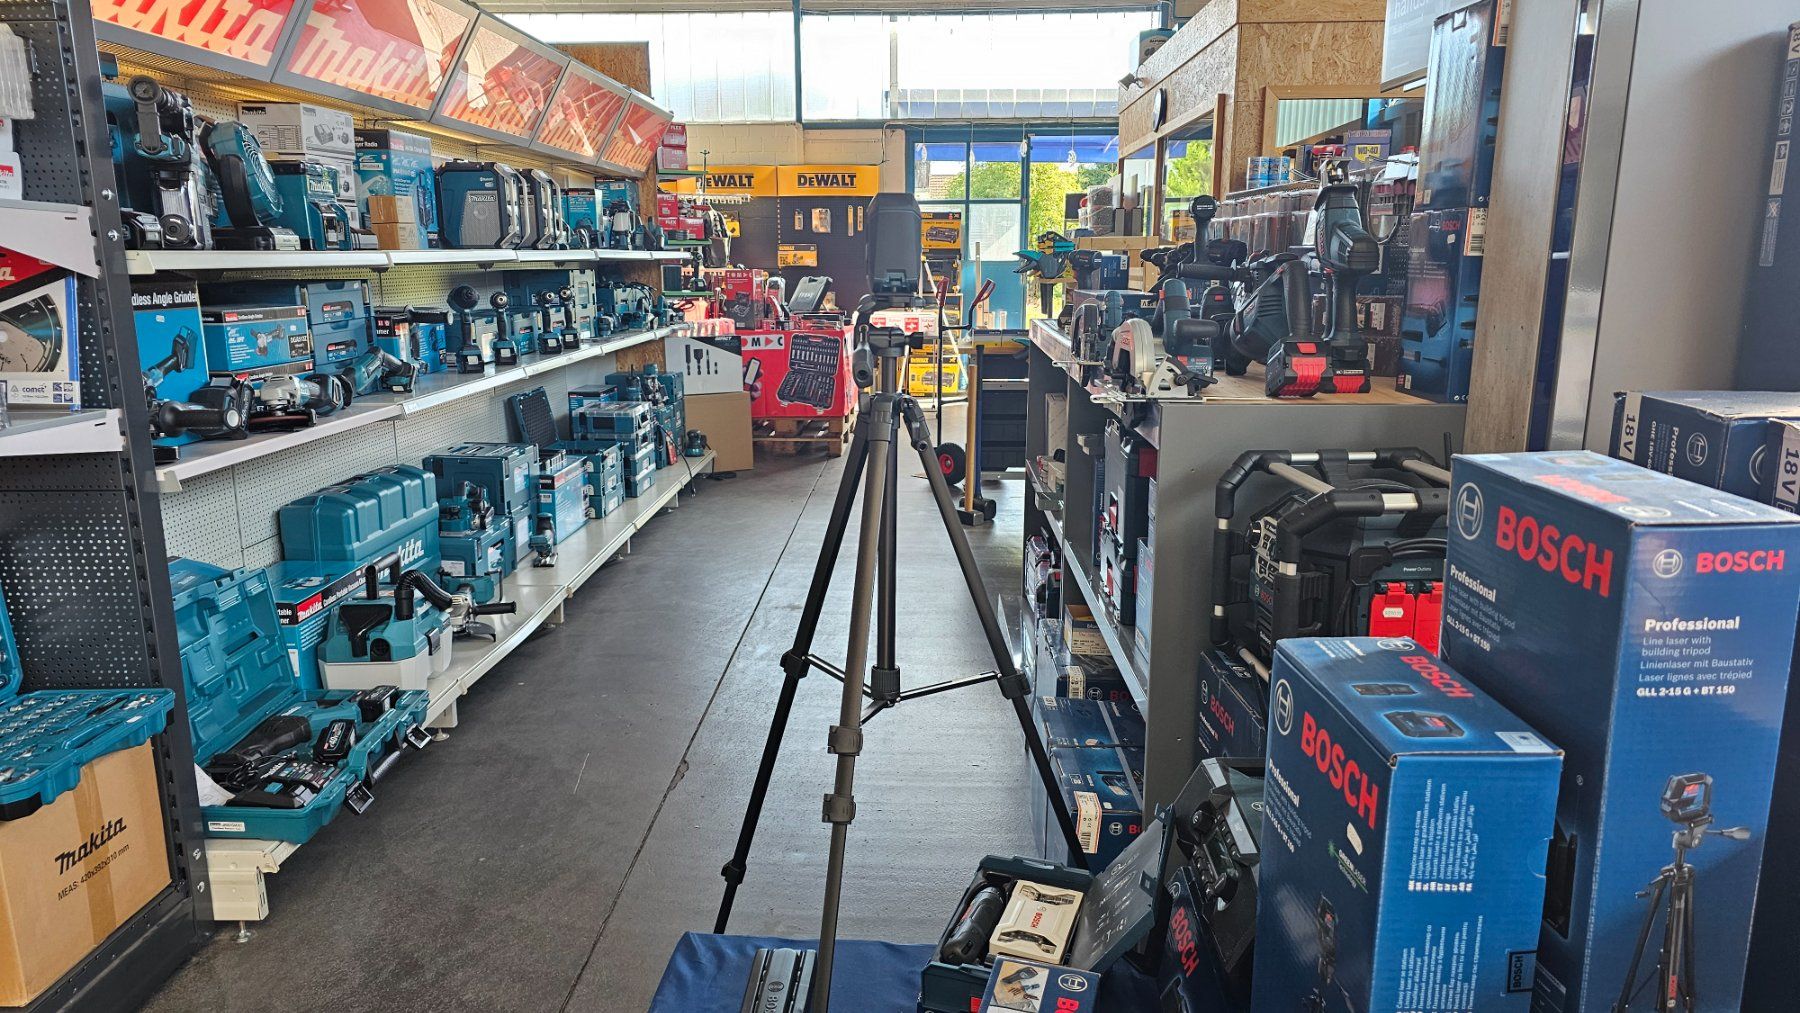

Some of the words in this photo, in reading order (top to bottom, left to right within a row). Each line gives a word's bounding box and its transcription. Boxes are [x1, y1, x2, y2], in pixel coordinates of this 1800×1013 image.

[152, 291, 173, 307] Angle
[22, 385, 46, 393] comet
[1782, 447, 1800, 496] 18V
[1496, 505, 1614, 597] BOSCH
[1696, 549, 1785, 575] BOSCH
[1450, 563, 1497, 603] Professional
[1644, 616, 1741, 632] Professional
[1642, 645, 1680, 657] building
[1682, 645, 1711, 657] tripod
[1643, 635, 1662, 646] Line
[1665, 635, 1688, 646] laser
[1691, 635, 1712, 645] with
[1640, 658, 1690, 669] Linienlaser
[1693, 658, 1708, 668] mit
[1711, 656, 1753, 667] Baustativ
[1400, 655, 1475, 699] BOSCH
[1639, 671, 1666, 681] Laser
[1669, 671, 1697, 683] lignes
[1700, 672, 1722, 681] avec
[1724, 669, 1753, 682] trépied
[1636, 687, 1658, 697] GLL
[1660, 686, 1682, 696] 2-15
[1683, 686, 1691, 695] G
[1693, 687, 1700, 695] +
[1700, 685, 1716, 695] BT
[1717, 684, 1735, 695] 150
[1210, 694, 1235, 737] BOSCH
[1301, 711, 1379, 829] BOSCH
[57, 881, 79, 901] MEAS:
[117, 844, 130, 857] mm
[1171, 906, 1200, 978] BOSCH
[1512, 955, 1524, 989] BOSCH
[1055, 996, 1080, 1013] B
